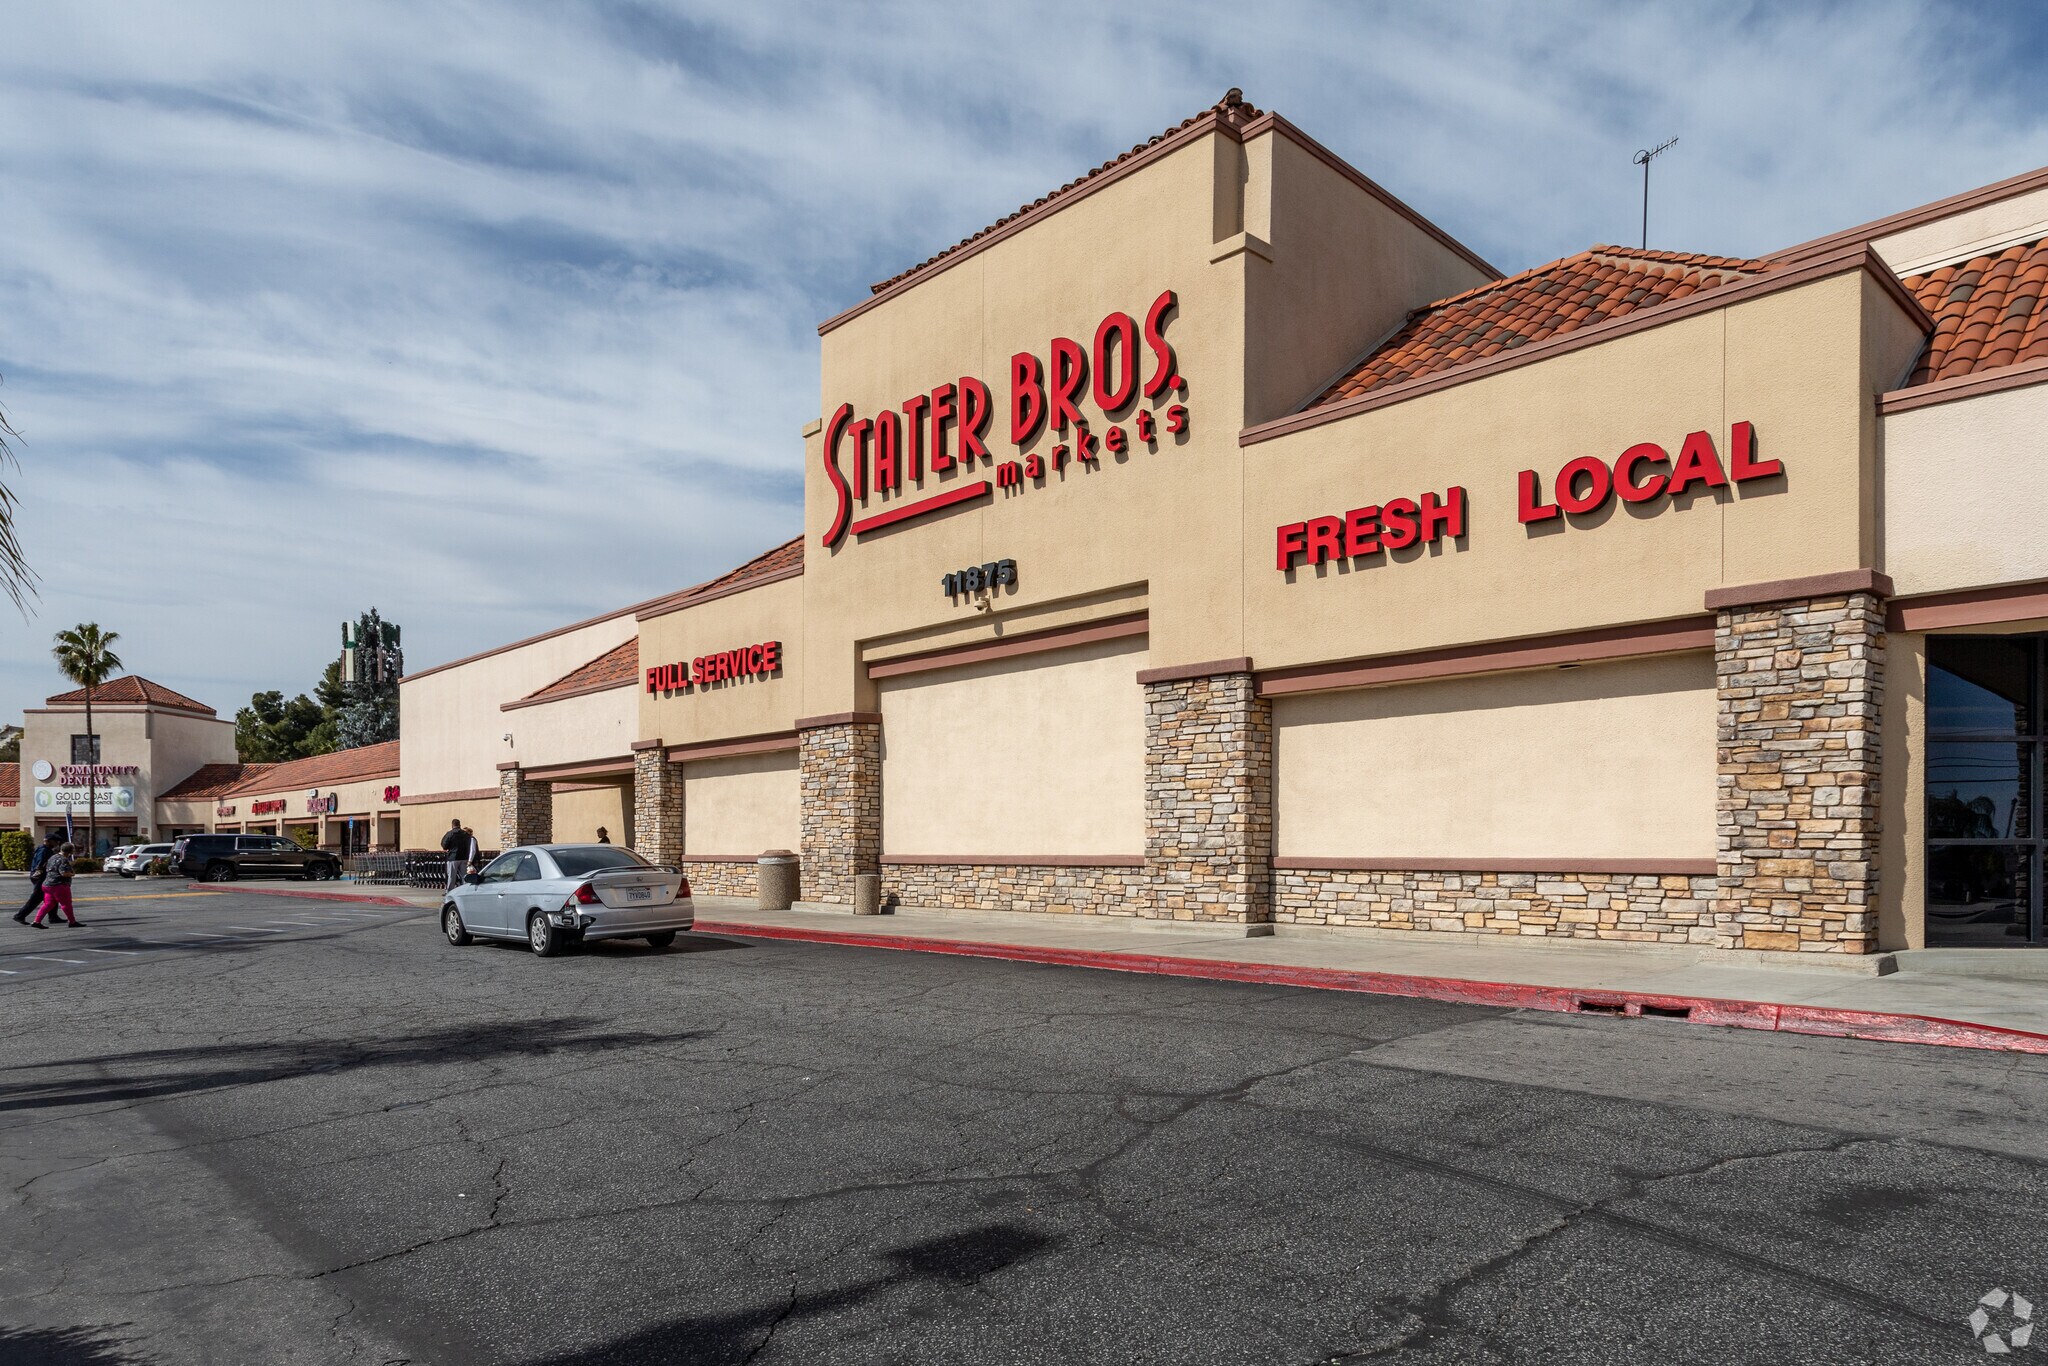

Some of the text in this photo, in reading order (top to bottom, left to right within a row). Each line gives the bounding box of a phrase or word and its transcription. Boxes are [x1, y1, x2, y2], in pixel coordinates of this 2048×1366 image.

[822, 289, 1188, 548] STATER BROS.
[996, 401, 1190, 488] markets
[1276, 420, 1784, 572] FRESH LOCAL
[941, 558, 1017, 597] 11875
[646, 640, 783, 694] FULL SERVICE
[59, 765, 139, 776] COMMUNITY
[59, 776, 108, 785] DENTAL
[56, 792, 81, 801] GOLD
